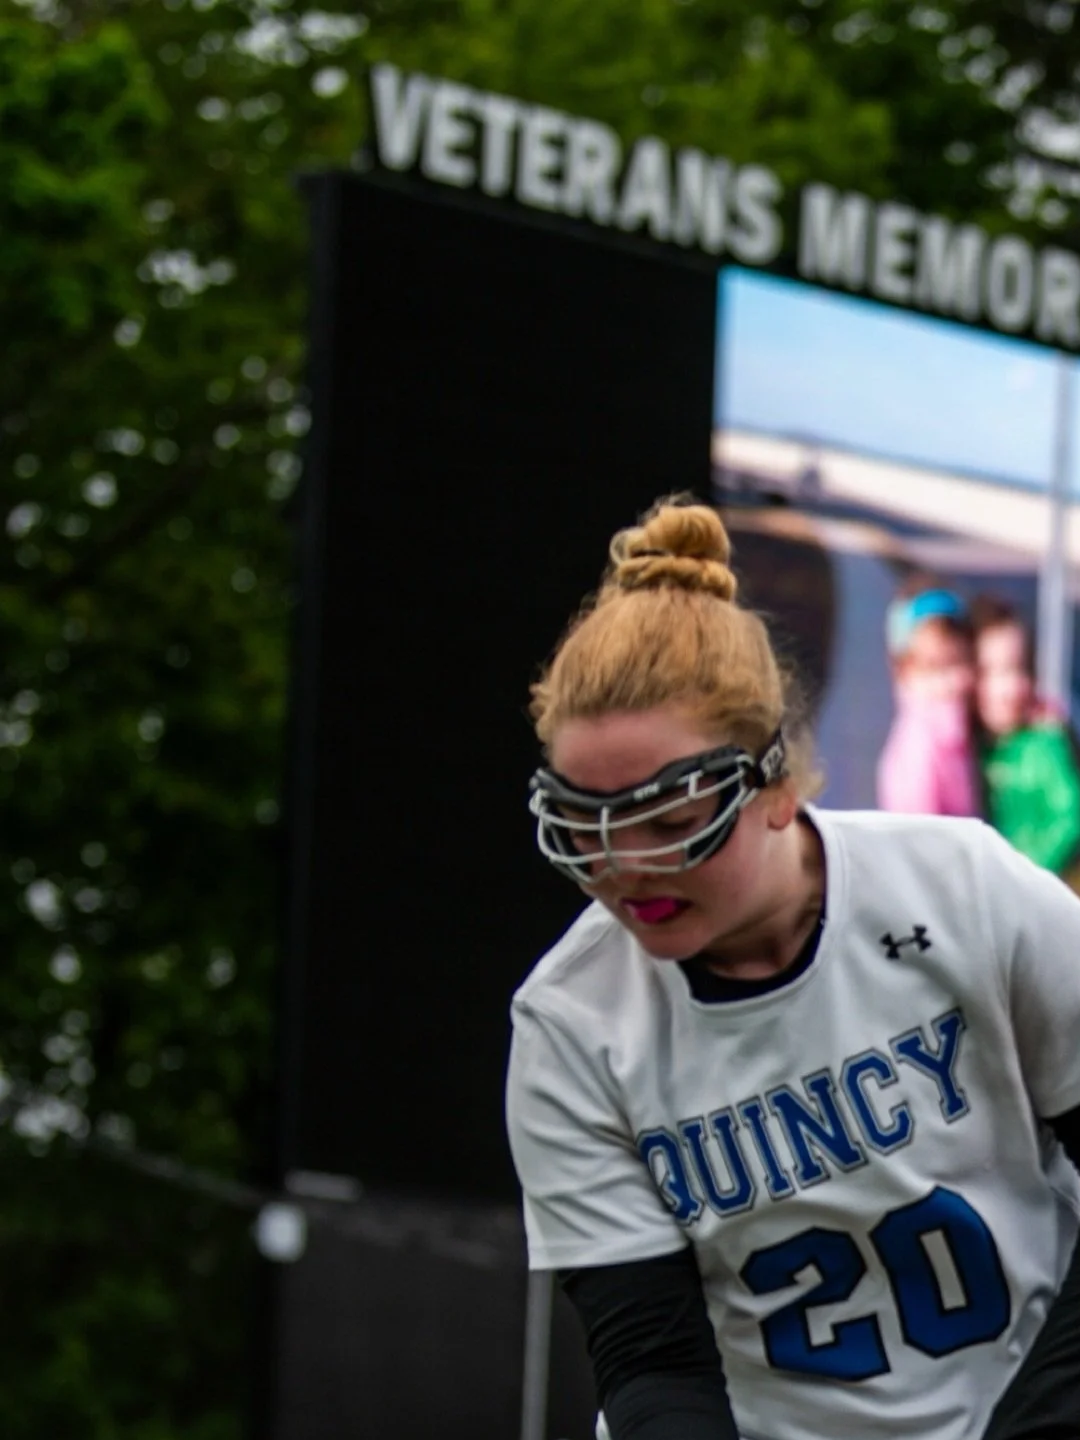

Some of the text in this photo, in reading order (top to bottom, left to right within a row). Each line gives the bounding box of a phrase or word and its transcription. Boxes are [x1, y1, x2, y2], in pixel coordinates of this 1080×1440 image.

[370, 62, 783, 265] VETERANS
[638, 1007, 968, 1226] QUINCY
[740, 1185, 1012, 1382] 20
